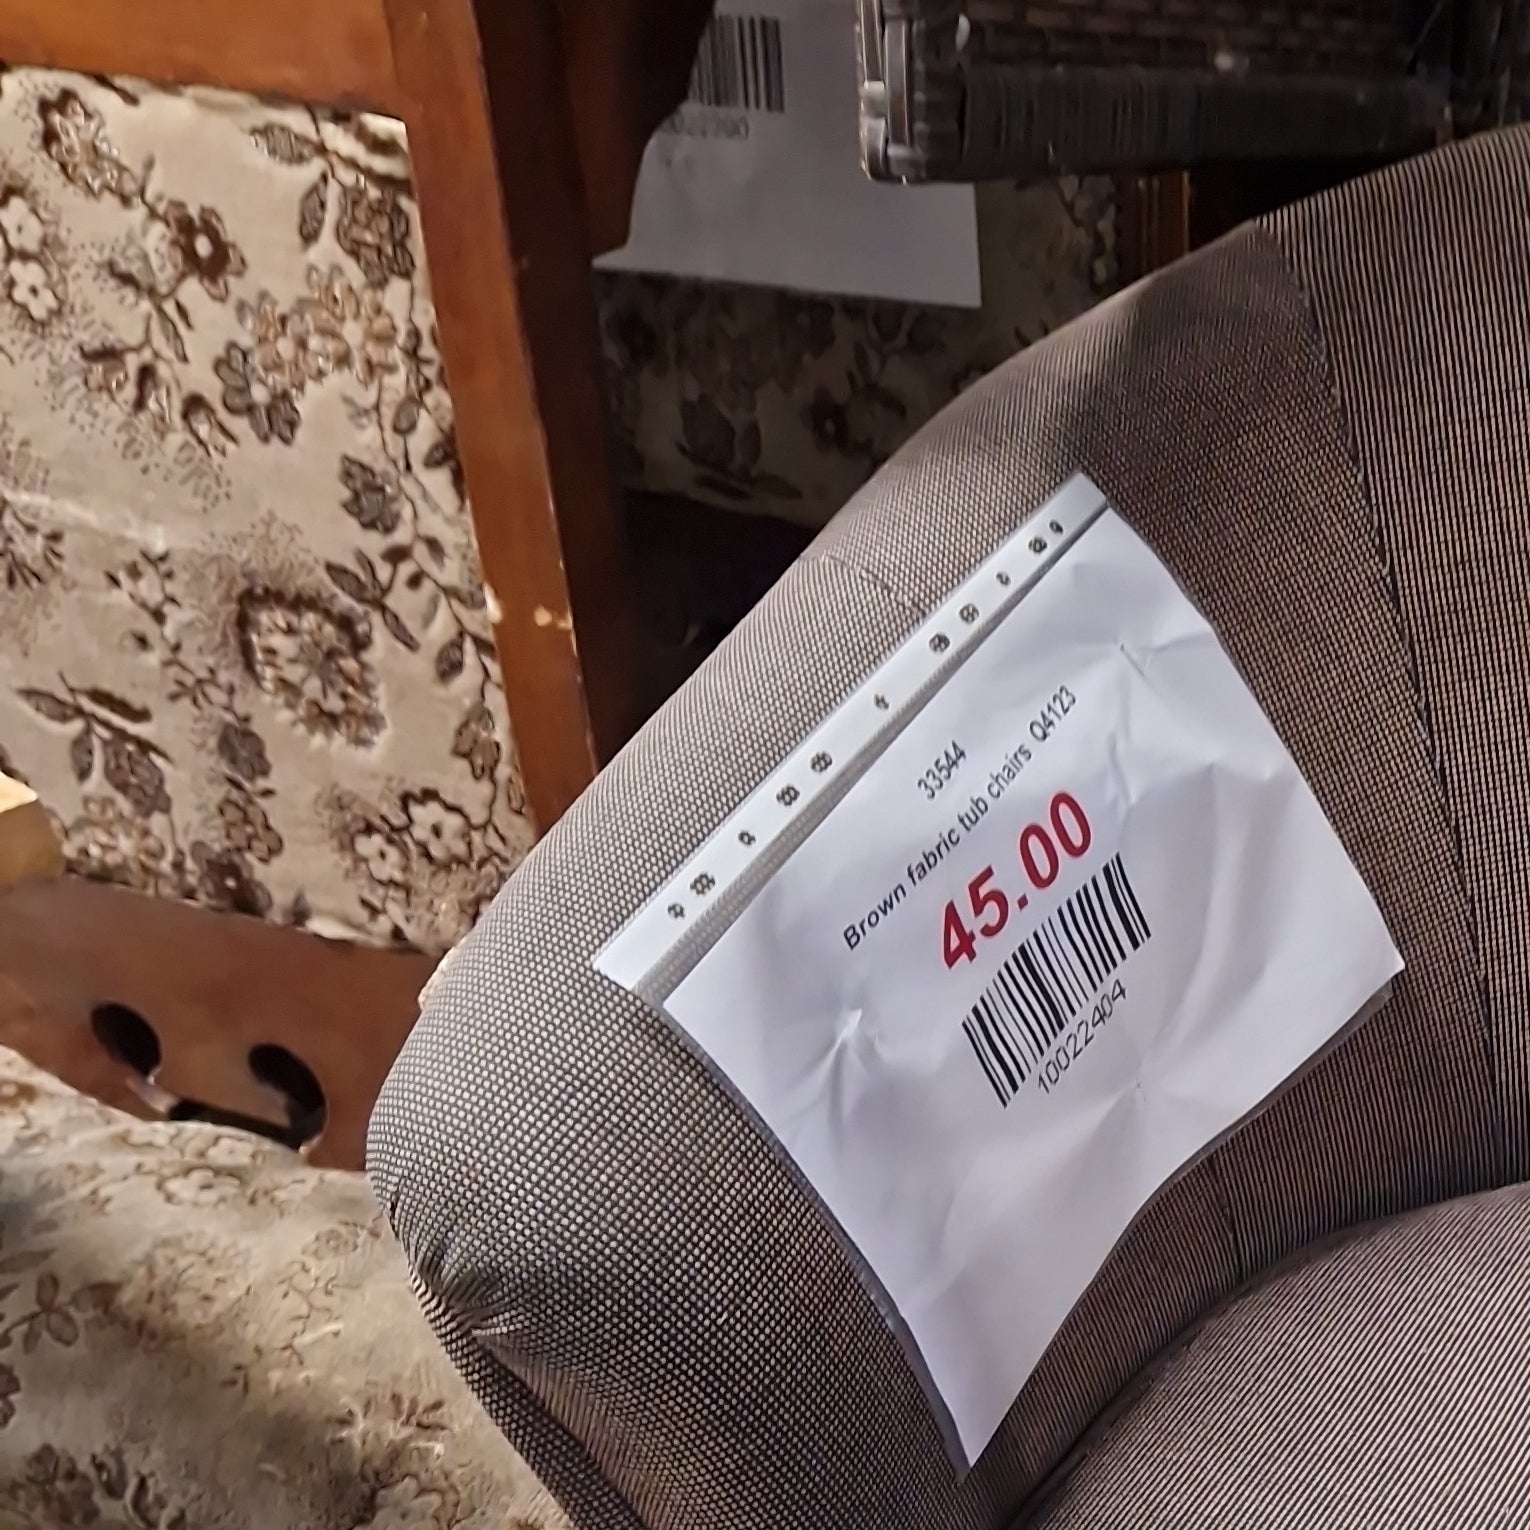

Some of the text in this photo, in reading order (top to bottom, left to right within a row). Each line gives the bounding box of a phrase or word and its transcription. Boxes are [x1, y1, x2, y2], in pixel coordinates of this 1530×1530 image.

[843, 685, 1077, 950] Brown fabric tub chairs Q4123
[918, 741, 967, 800] 33544
[942, 792, 1091, 969] 45.00
[1037, 979, 1127, 1094] 10022404
